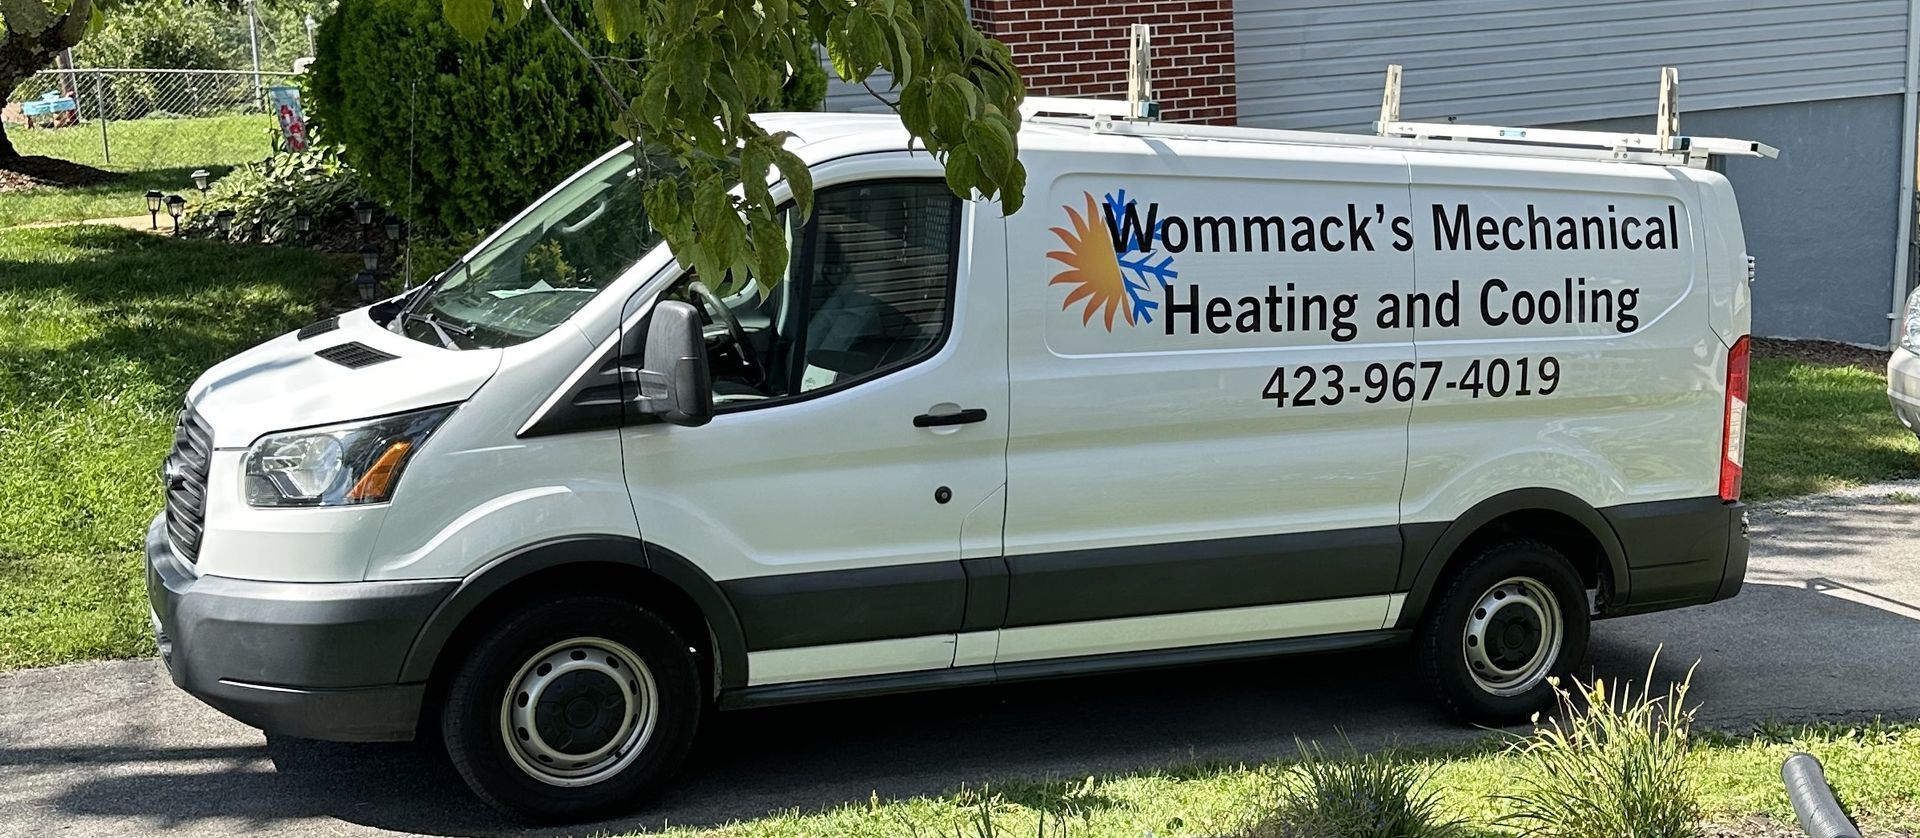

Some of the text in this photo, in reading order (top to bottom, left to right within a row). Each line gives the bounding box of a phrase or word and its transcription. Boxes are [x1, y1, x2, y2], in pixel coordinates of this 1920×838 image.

[1102, 202, 1679, 254] Wommack's Mechanical
[1163, 278, 1640, 342] Heating and Cooling
[1262, 356, 1561, 408] 423-967-4019
